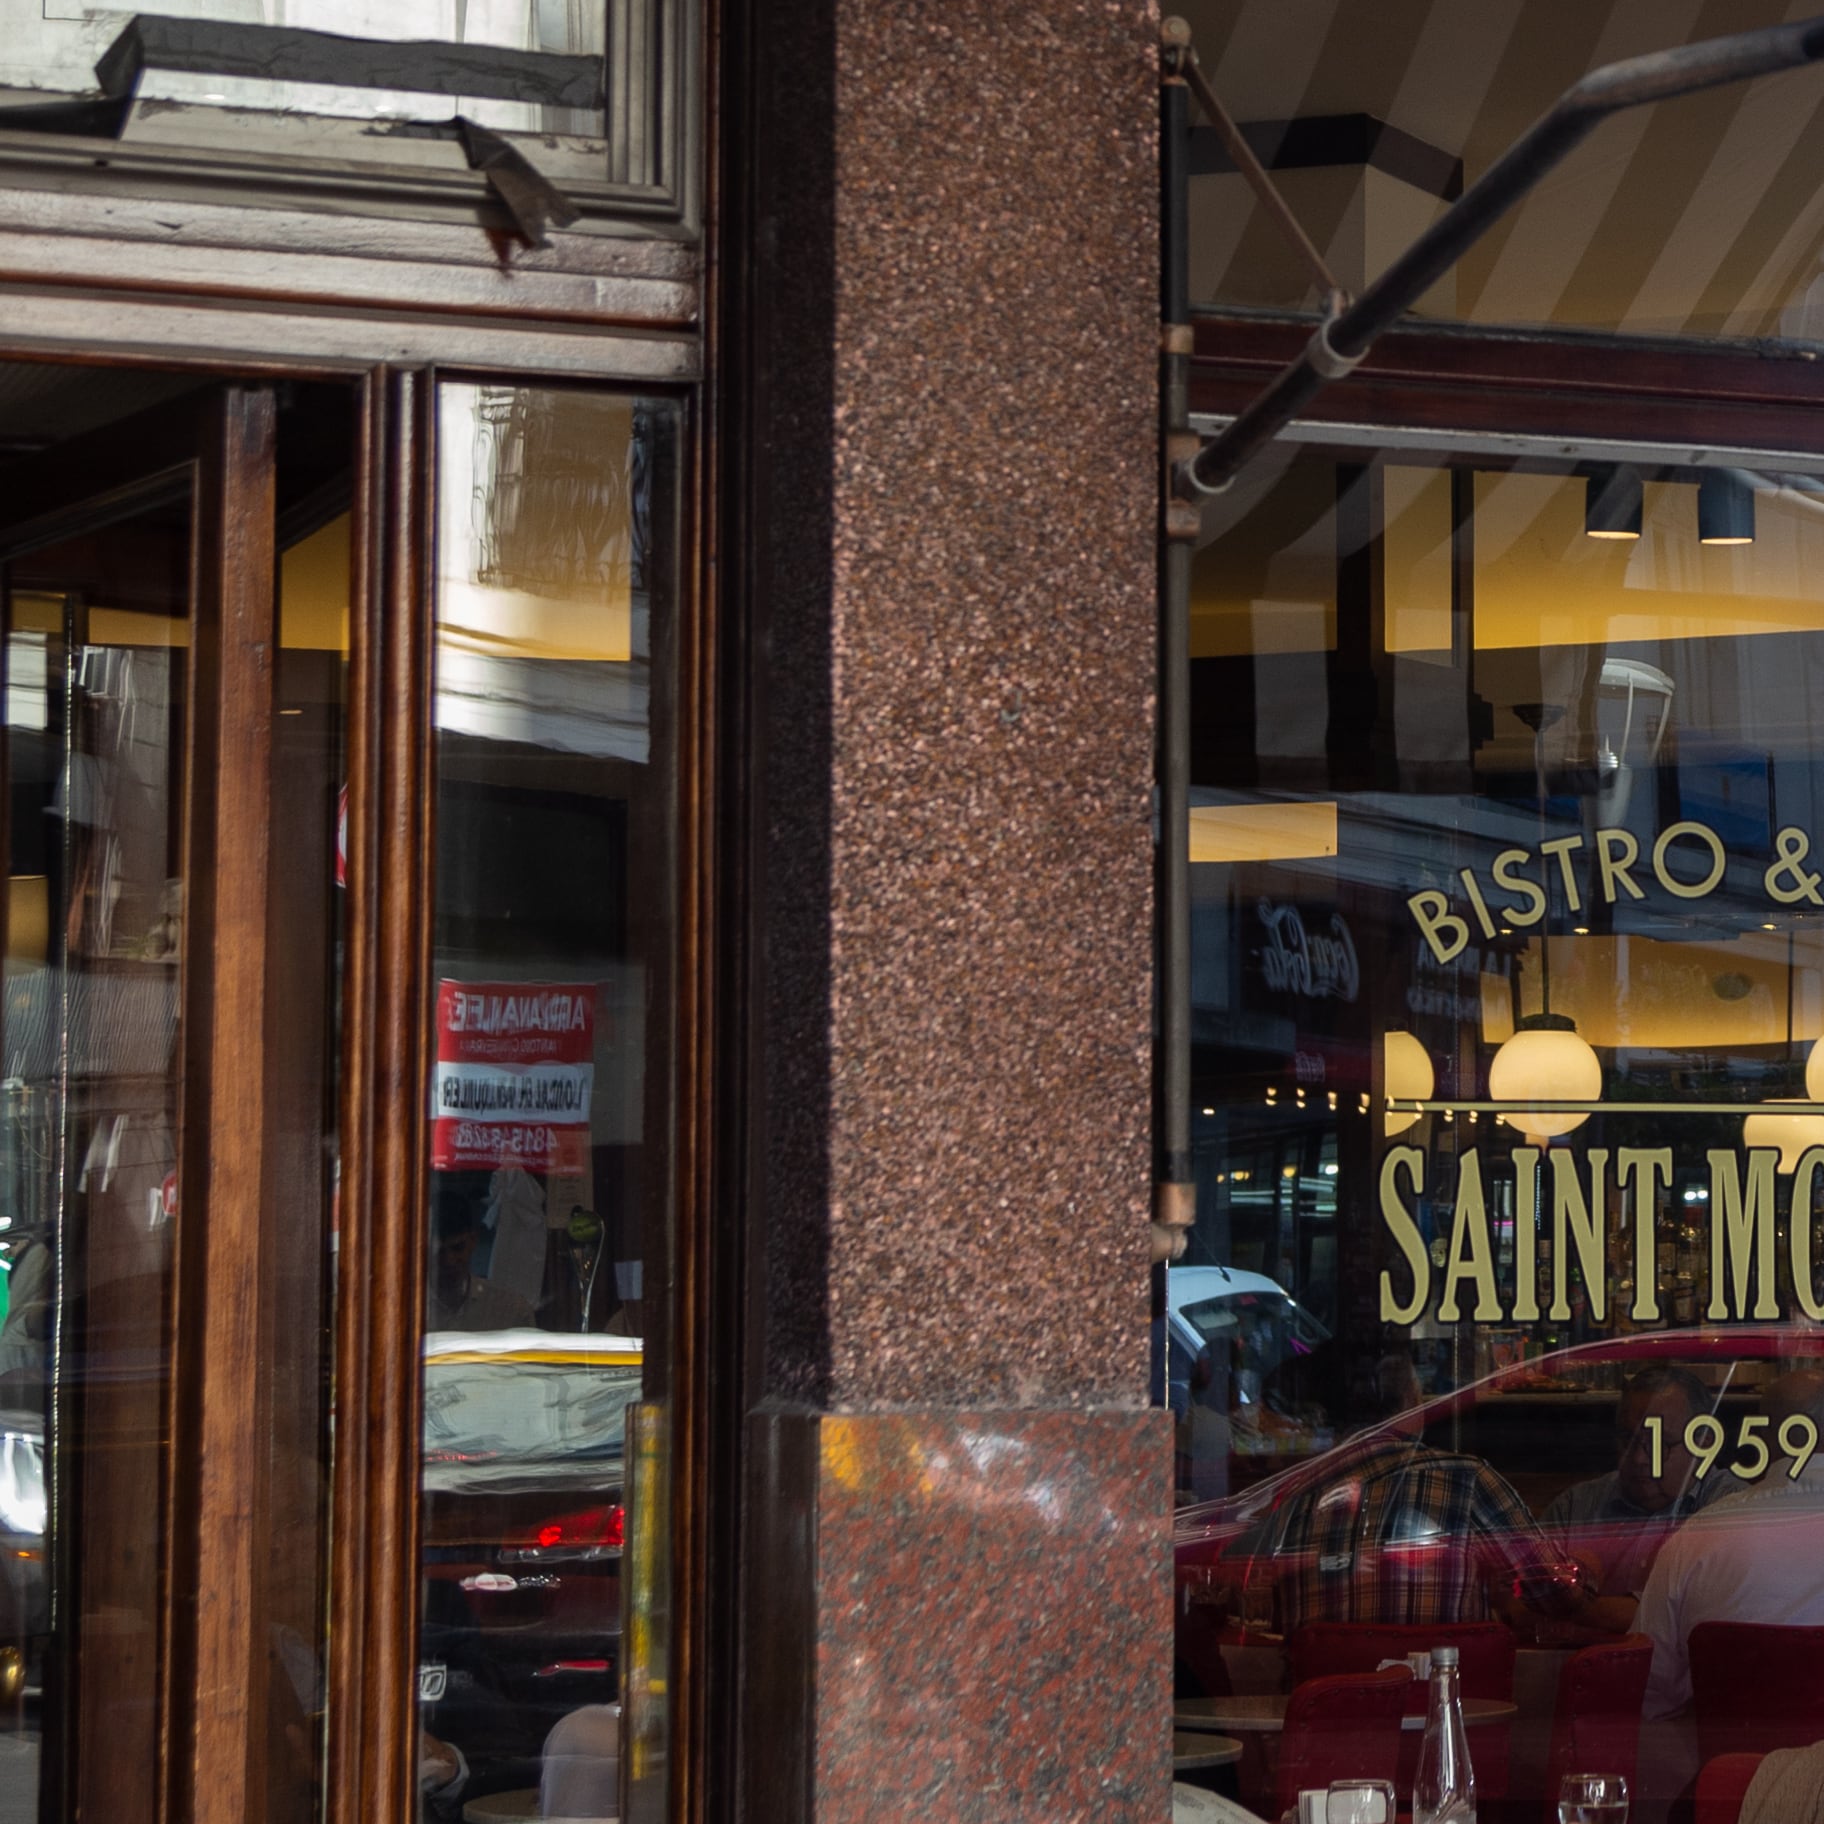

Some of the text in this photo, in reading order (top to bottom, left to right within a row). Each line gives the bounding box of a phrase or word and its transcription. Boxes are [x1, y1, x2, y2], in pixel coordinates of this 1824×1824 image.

[1406, 821, 1727, 965] BISTRO
[1764, 826, 1824, 907] &
[1379, 1145, 1673, 1325] SAINT
[1643, 1414, 1818, 1480] 1959
